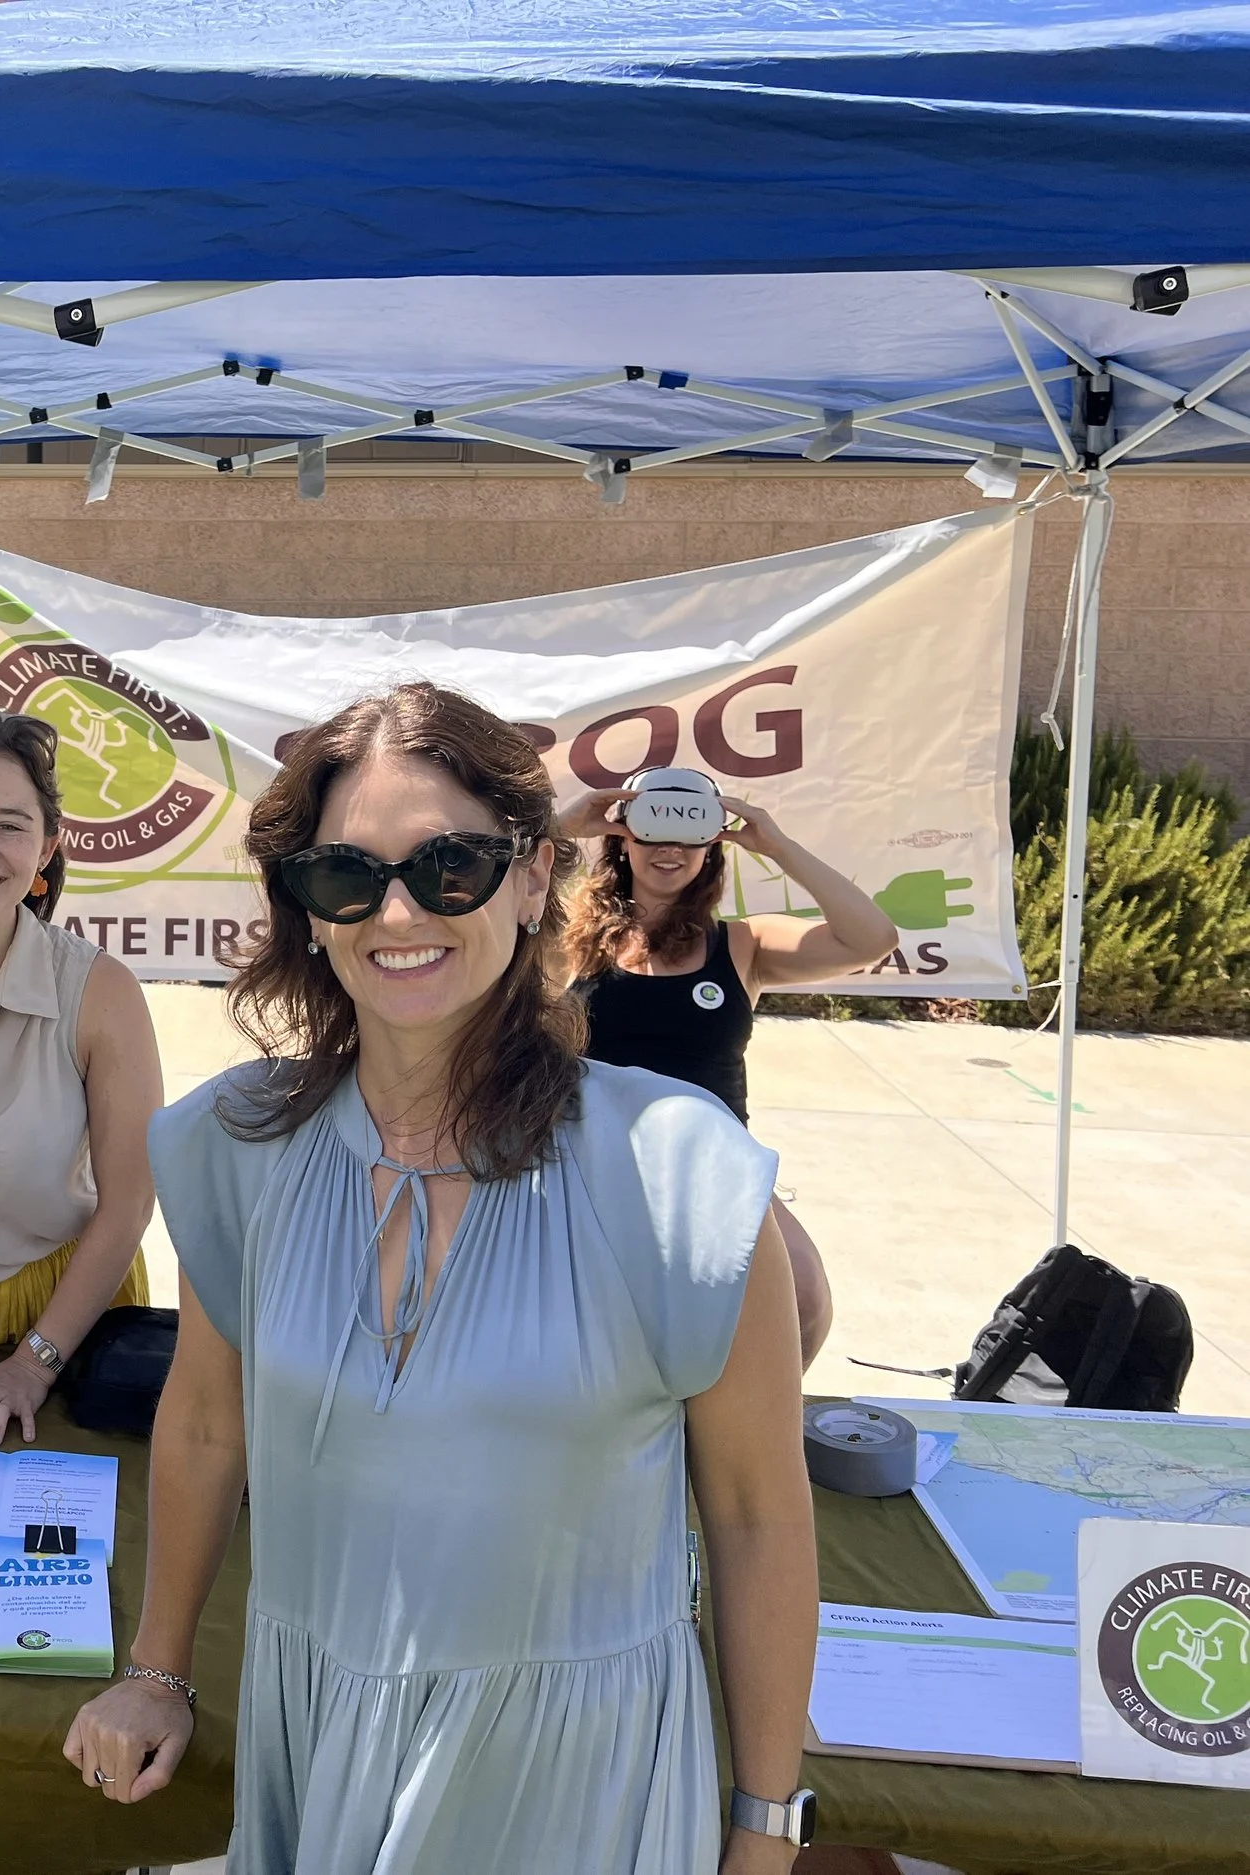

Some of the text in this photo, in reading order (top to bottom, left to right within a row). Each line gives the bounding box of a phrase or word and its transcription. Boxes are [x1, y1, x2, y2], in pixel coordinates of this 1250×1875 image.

[108, 659, 191, 734] FIRST:
[101, 829, 135, 850] OIL
[139, 822, 156, 839] &
[156, 791, 192, 826] GAS
[650, 805, 706, 819] VINCI
[848, 942, 948, 975] AS
[830, 1613, 944, 1629] CFROG Action Alerts
[1110, 1569, 1250, 1631] CLIMATE FIR
[1118, 1687, 1247, 1746] REPLACING OIL &
